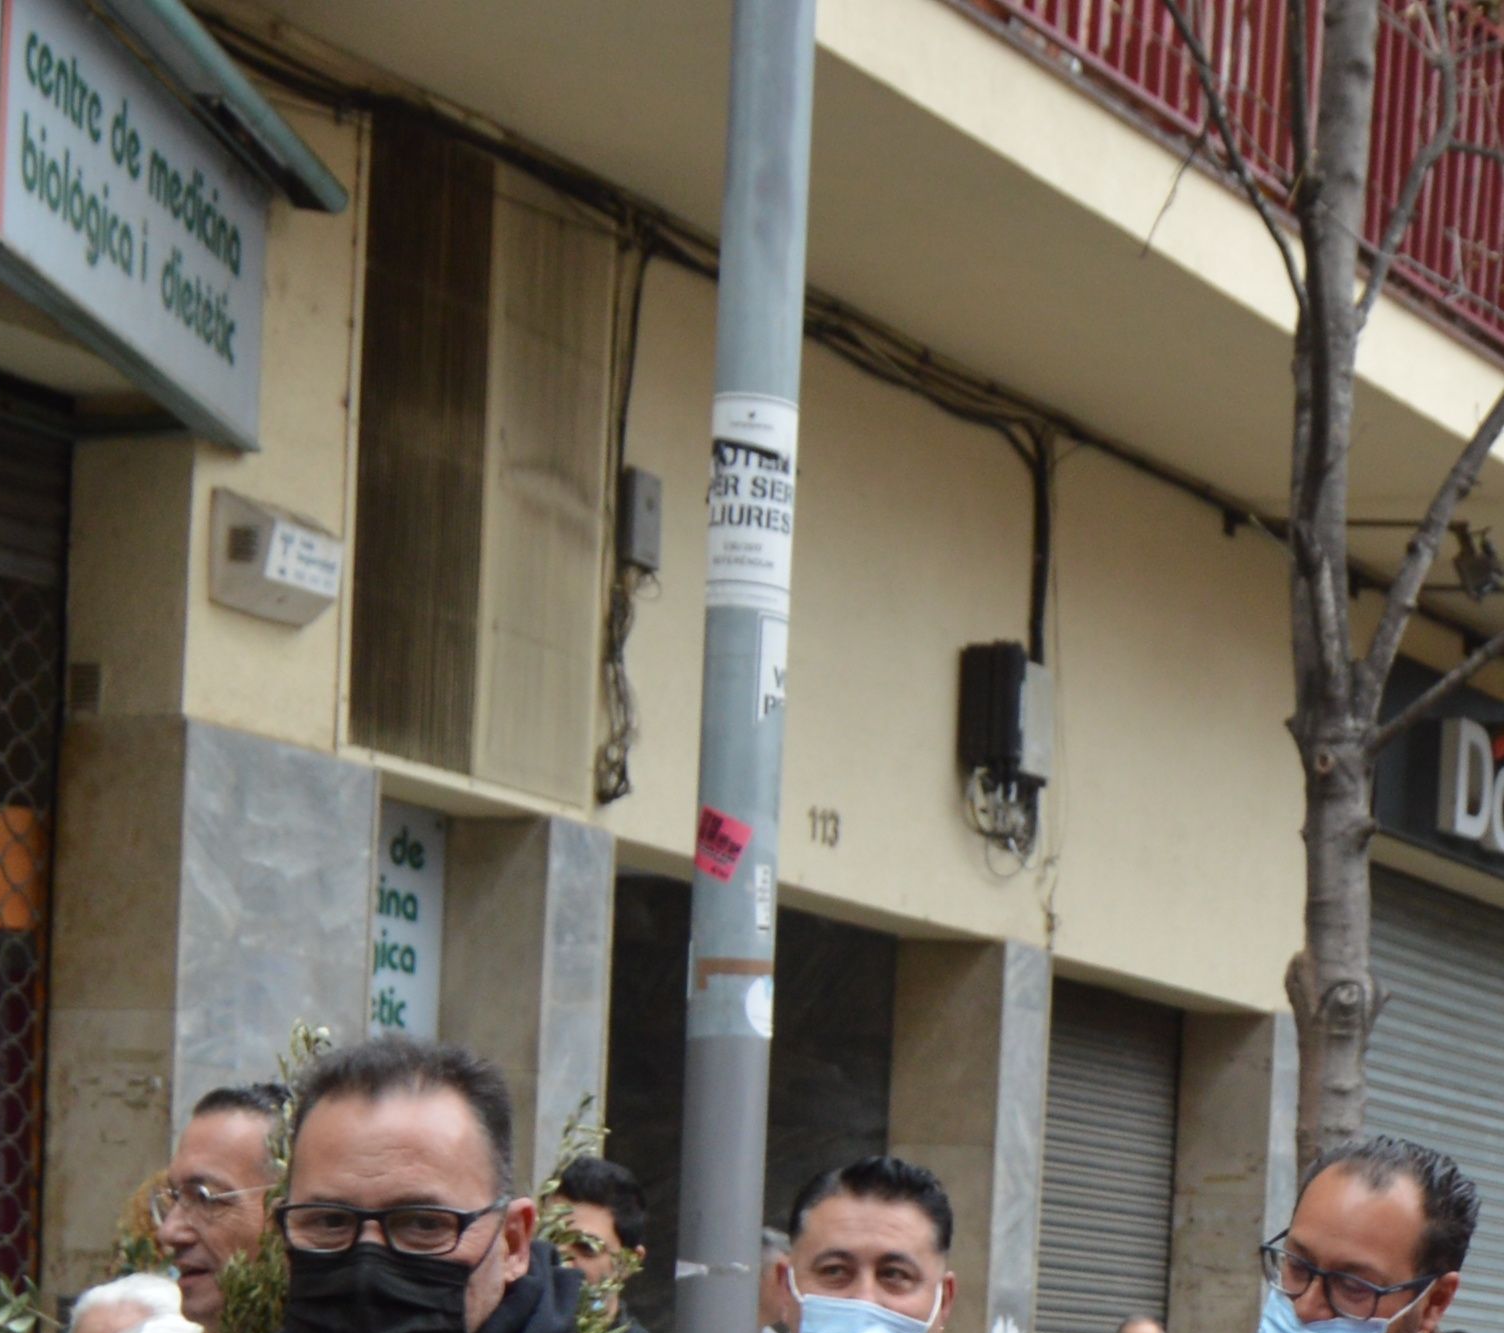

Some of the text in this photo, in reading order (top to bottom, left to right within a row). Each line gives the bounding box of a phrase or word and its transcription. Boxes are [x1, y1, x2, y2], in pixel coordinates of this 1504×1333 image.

[25, 31, 242, 278] centre de medicina
[140, 218, 148, 282] i
[390, 824, 426, 870] de
[809, 806, 840, 848] 113
